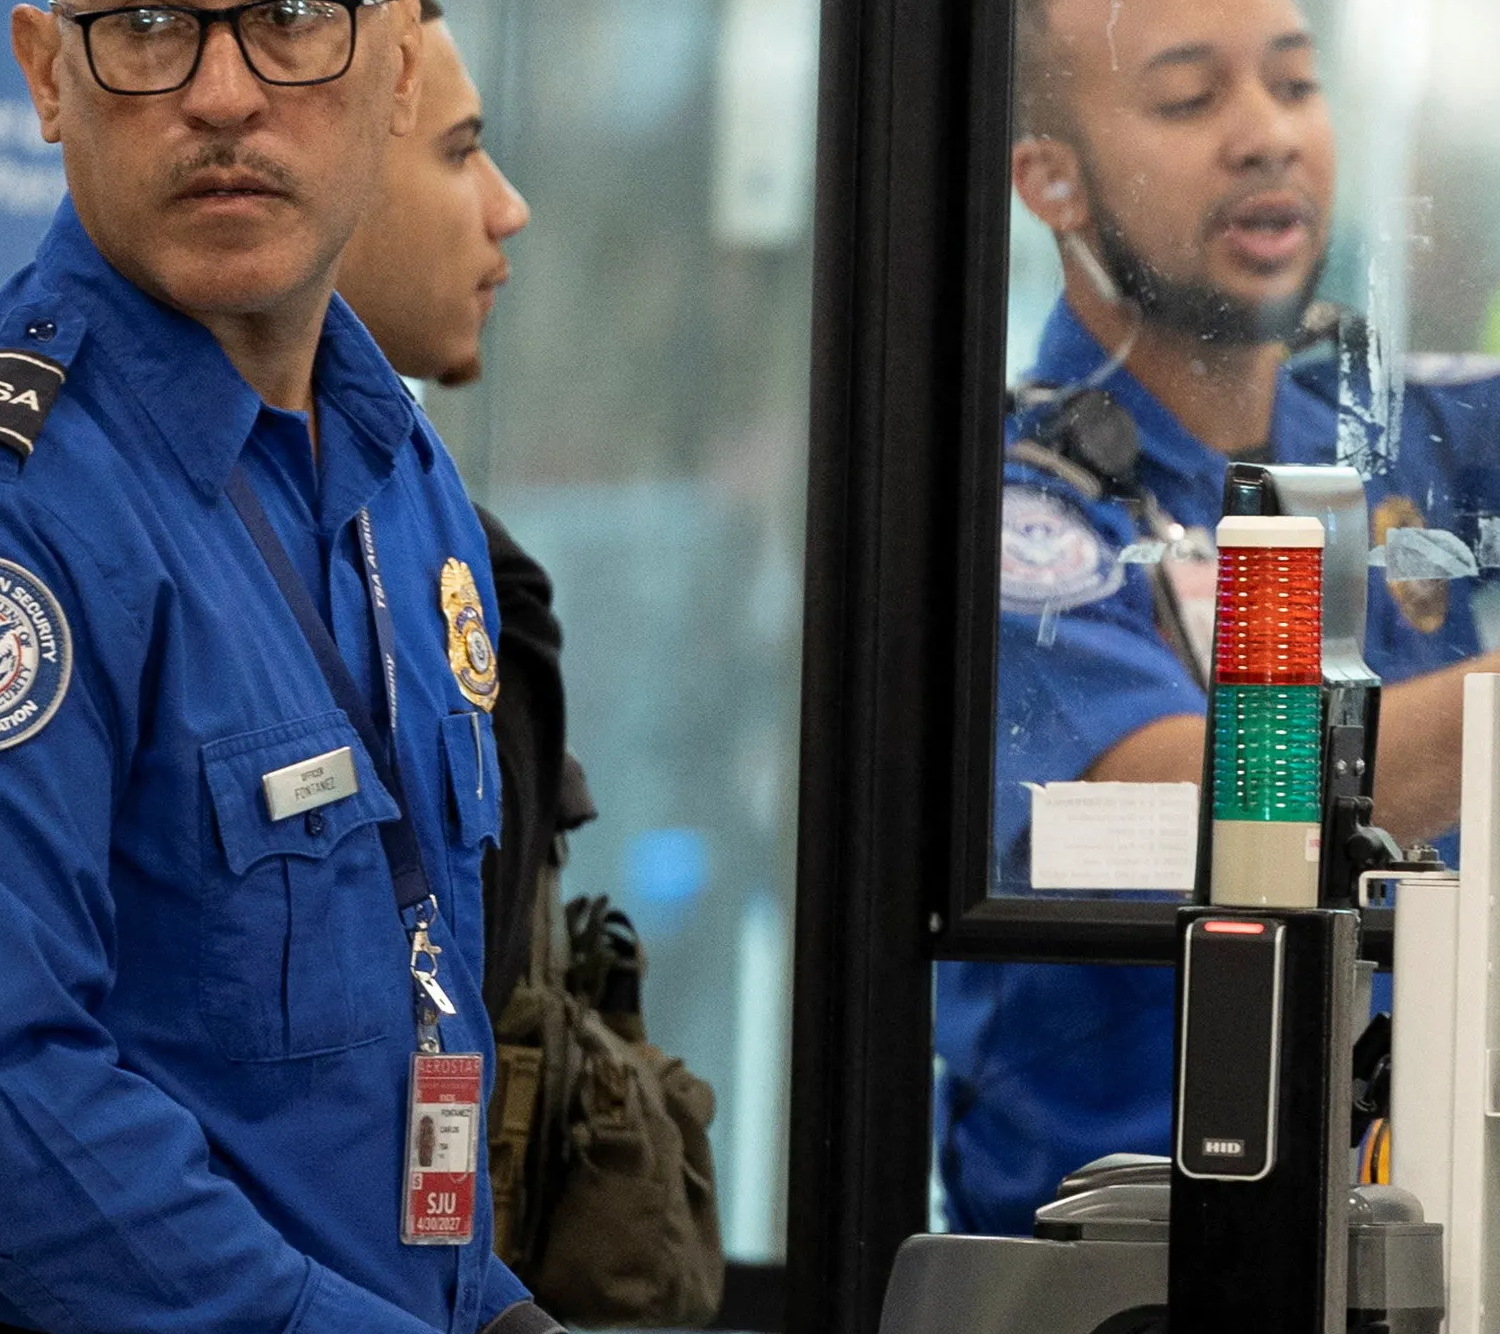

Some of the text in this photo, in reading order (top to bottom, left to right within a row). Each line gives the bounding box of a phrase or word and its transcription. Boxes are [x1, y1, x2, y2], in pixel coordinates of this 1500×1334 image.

[10, 586, 58, 664] SECURITY
[1205, 1141, 1242, 1154] HID
[426, 1192, 457, 1215] SJU
